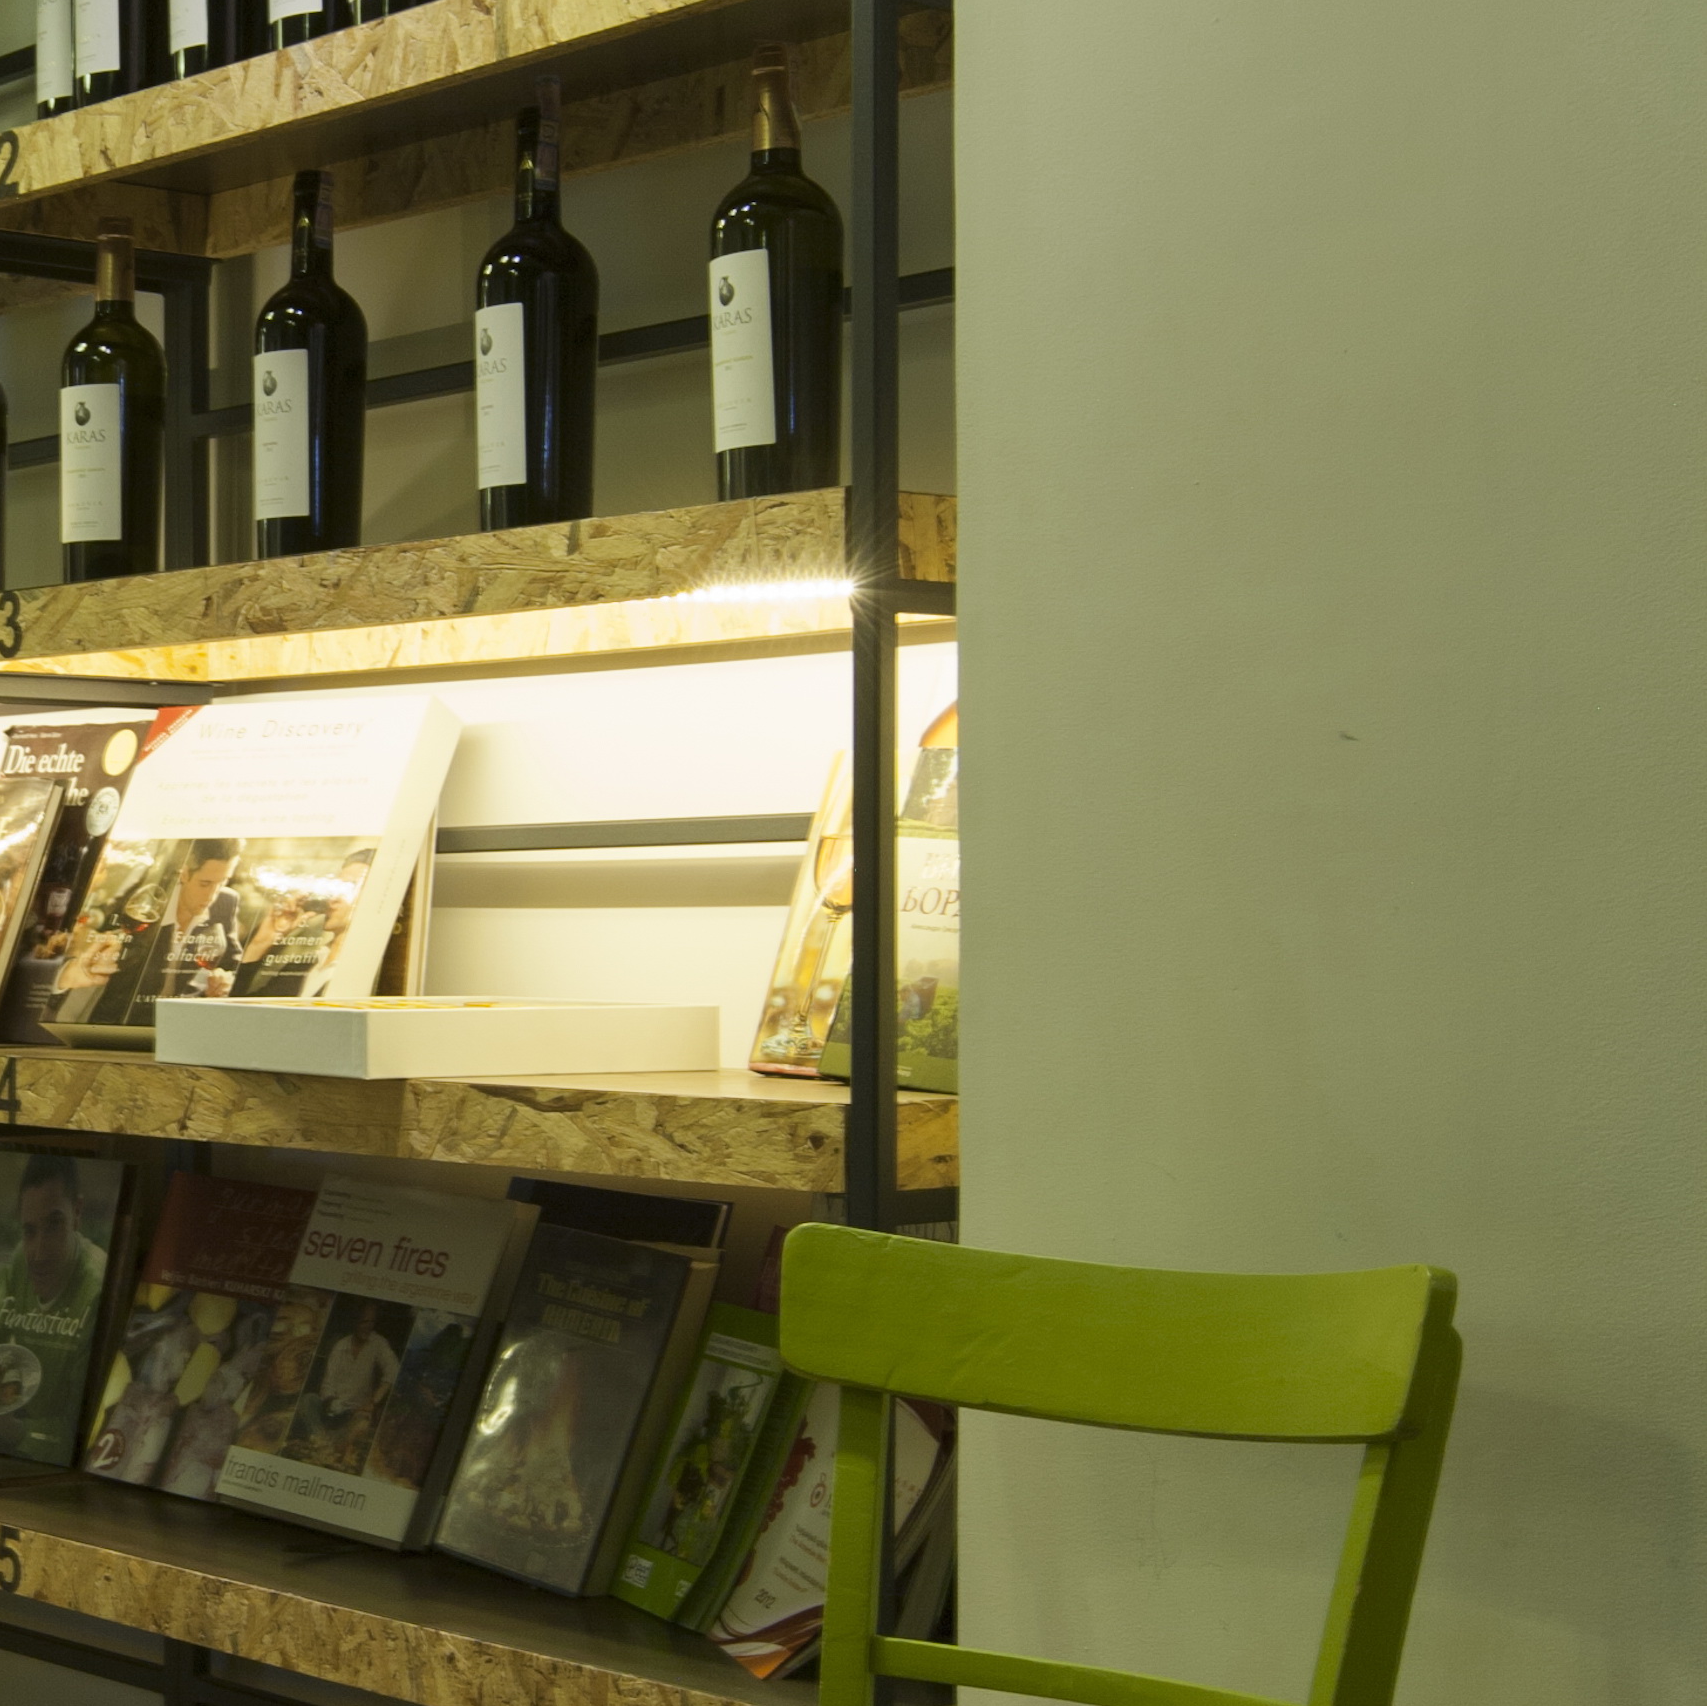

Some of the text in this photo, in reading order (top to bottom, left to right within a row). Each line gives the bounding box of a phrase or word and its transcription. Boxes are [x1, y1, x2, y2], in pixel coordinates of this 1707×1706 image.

[66, 429, 106, 446] KARAS
[198, 721, 247, 740] Wine
[261, 718, 364, 740] Discovery
[4, 743, 85, 774] Die echte
[901, 887, 960, 916] БОР
[272, 933, 323, 946] Examen
[264, 951, 320, 966] gustatif
[304, 1228, 450, 1279] seven fires
[93, 1433, 120, 1469] 2.
[223, 1456, 367, 1512] francis mallmann
[754, 1587, 776, 1610] 2012
